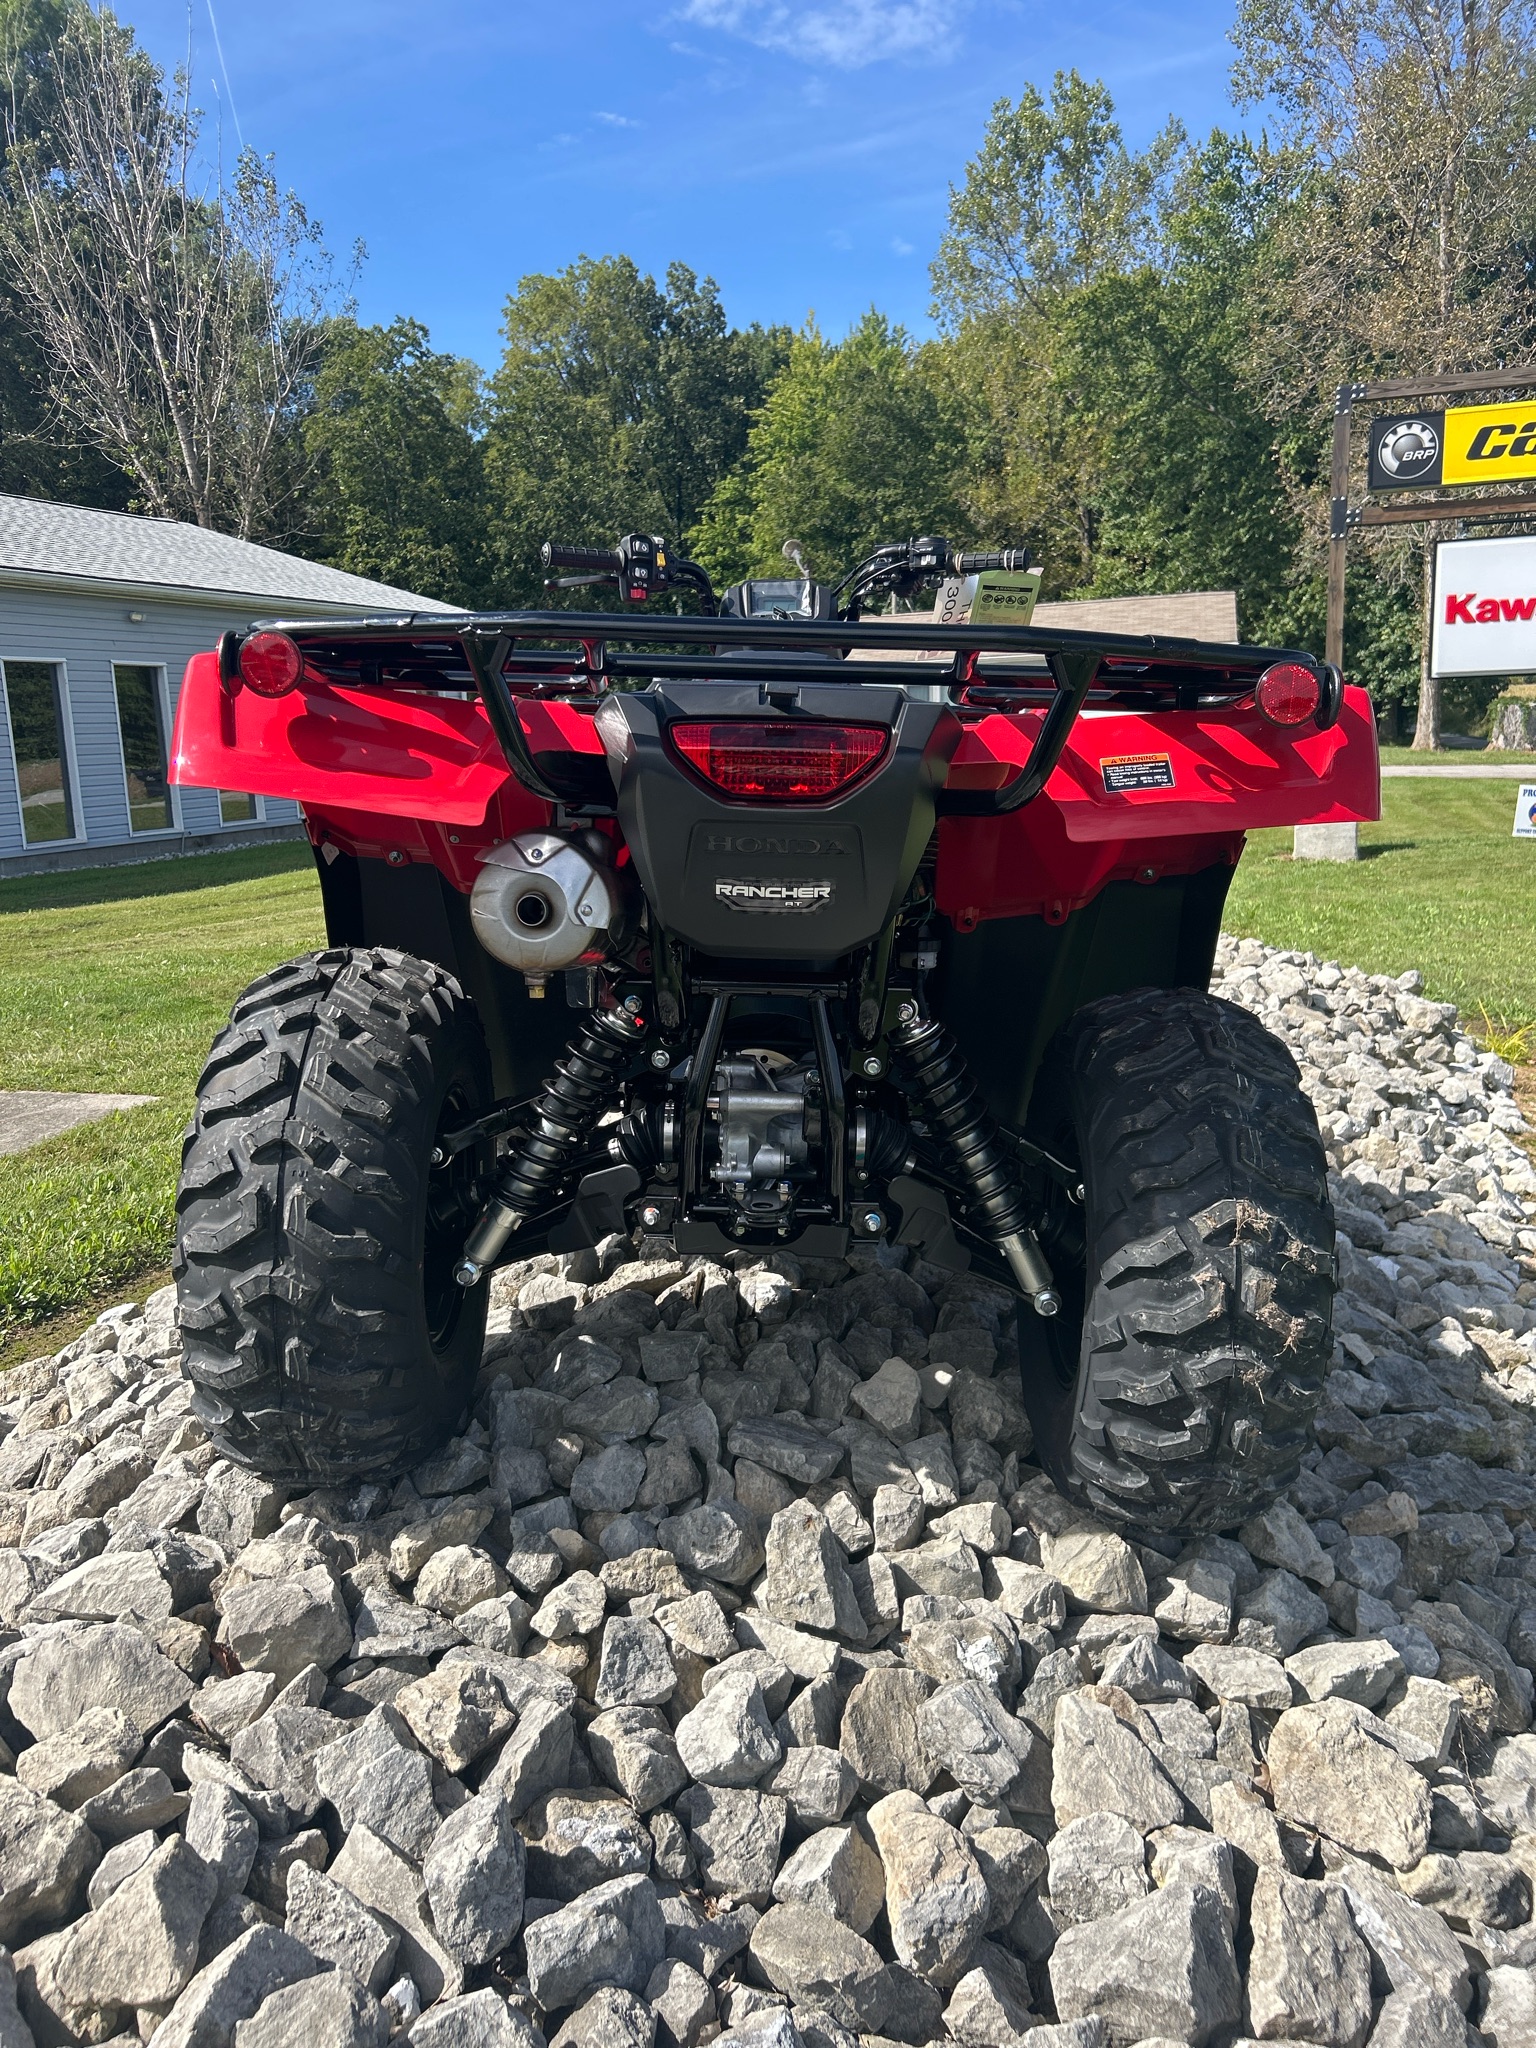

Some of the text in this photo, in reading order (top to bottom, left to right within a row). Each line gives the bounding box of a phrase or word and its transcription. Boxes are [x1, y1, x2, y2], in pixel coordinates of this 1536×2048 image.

[1402, 449, 1435, 462] BRP
[941, 586, 960, 625] 300
[1445, 593, 1536, 625] Kaw
[1118, 755, 1158, 763] WARNING
[707, 835, 851, 854] HONDA
[715, 884, 831, 898] RANCHER
